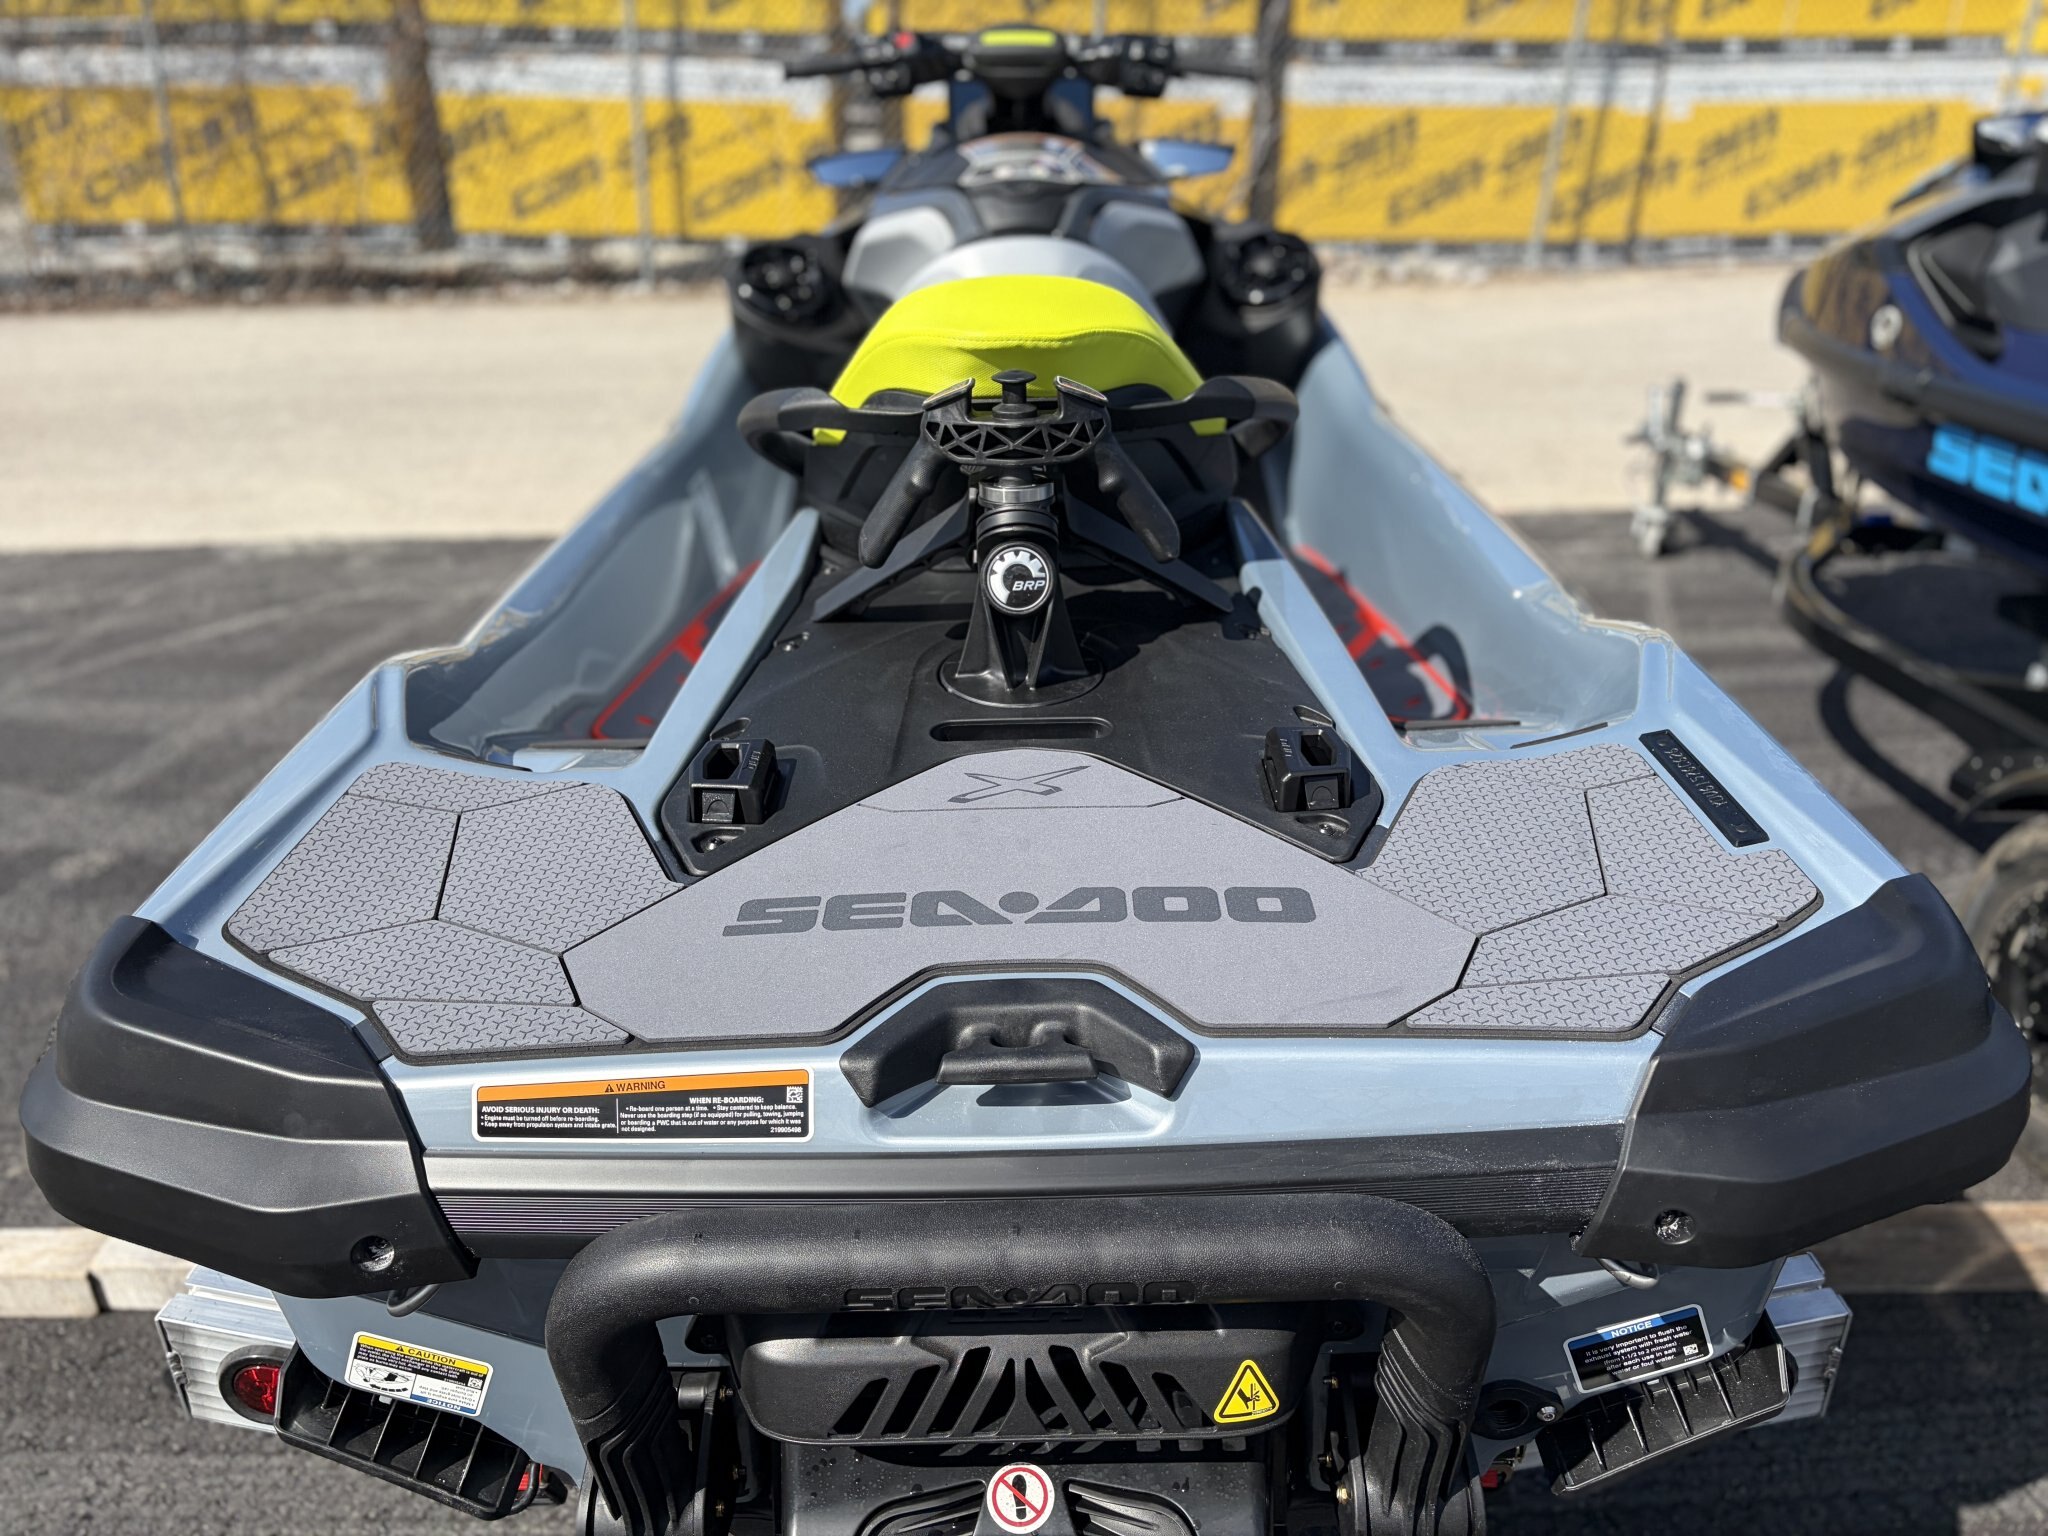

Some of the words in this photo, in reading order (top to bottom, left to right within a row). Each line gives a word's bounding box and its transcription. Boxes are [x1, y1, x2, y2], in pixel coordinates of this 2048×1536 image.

[1012, 580, 1046, 591] BRP
[616, 1080, 666, 1092] WARNING
[712, 1096, 764, 1104] RE-BOARDING:
[536, 1106, 560, 1114] INJURY
[1611, 1321, 1652, 1338] NOTICE
[408, 1348, 456, 1365] CAUTION
